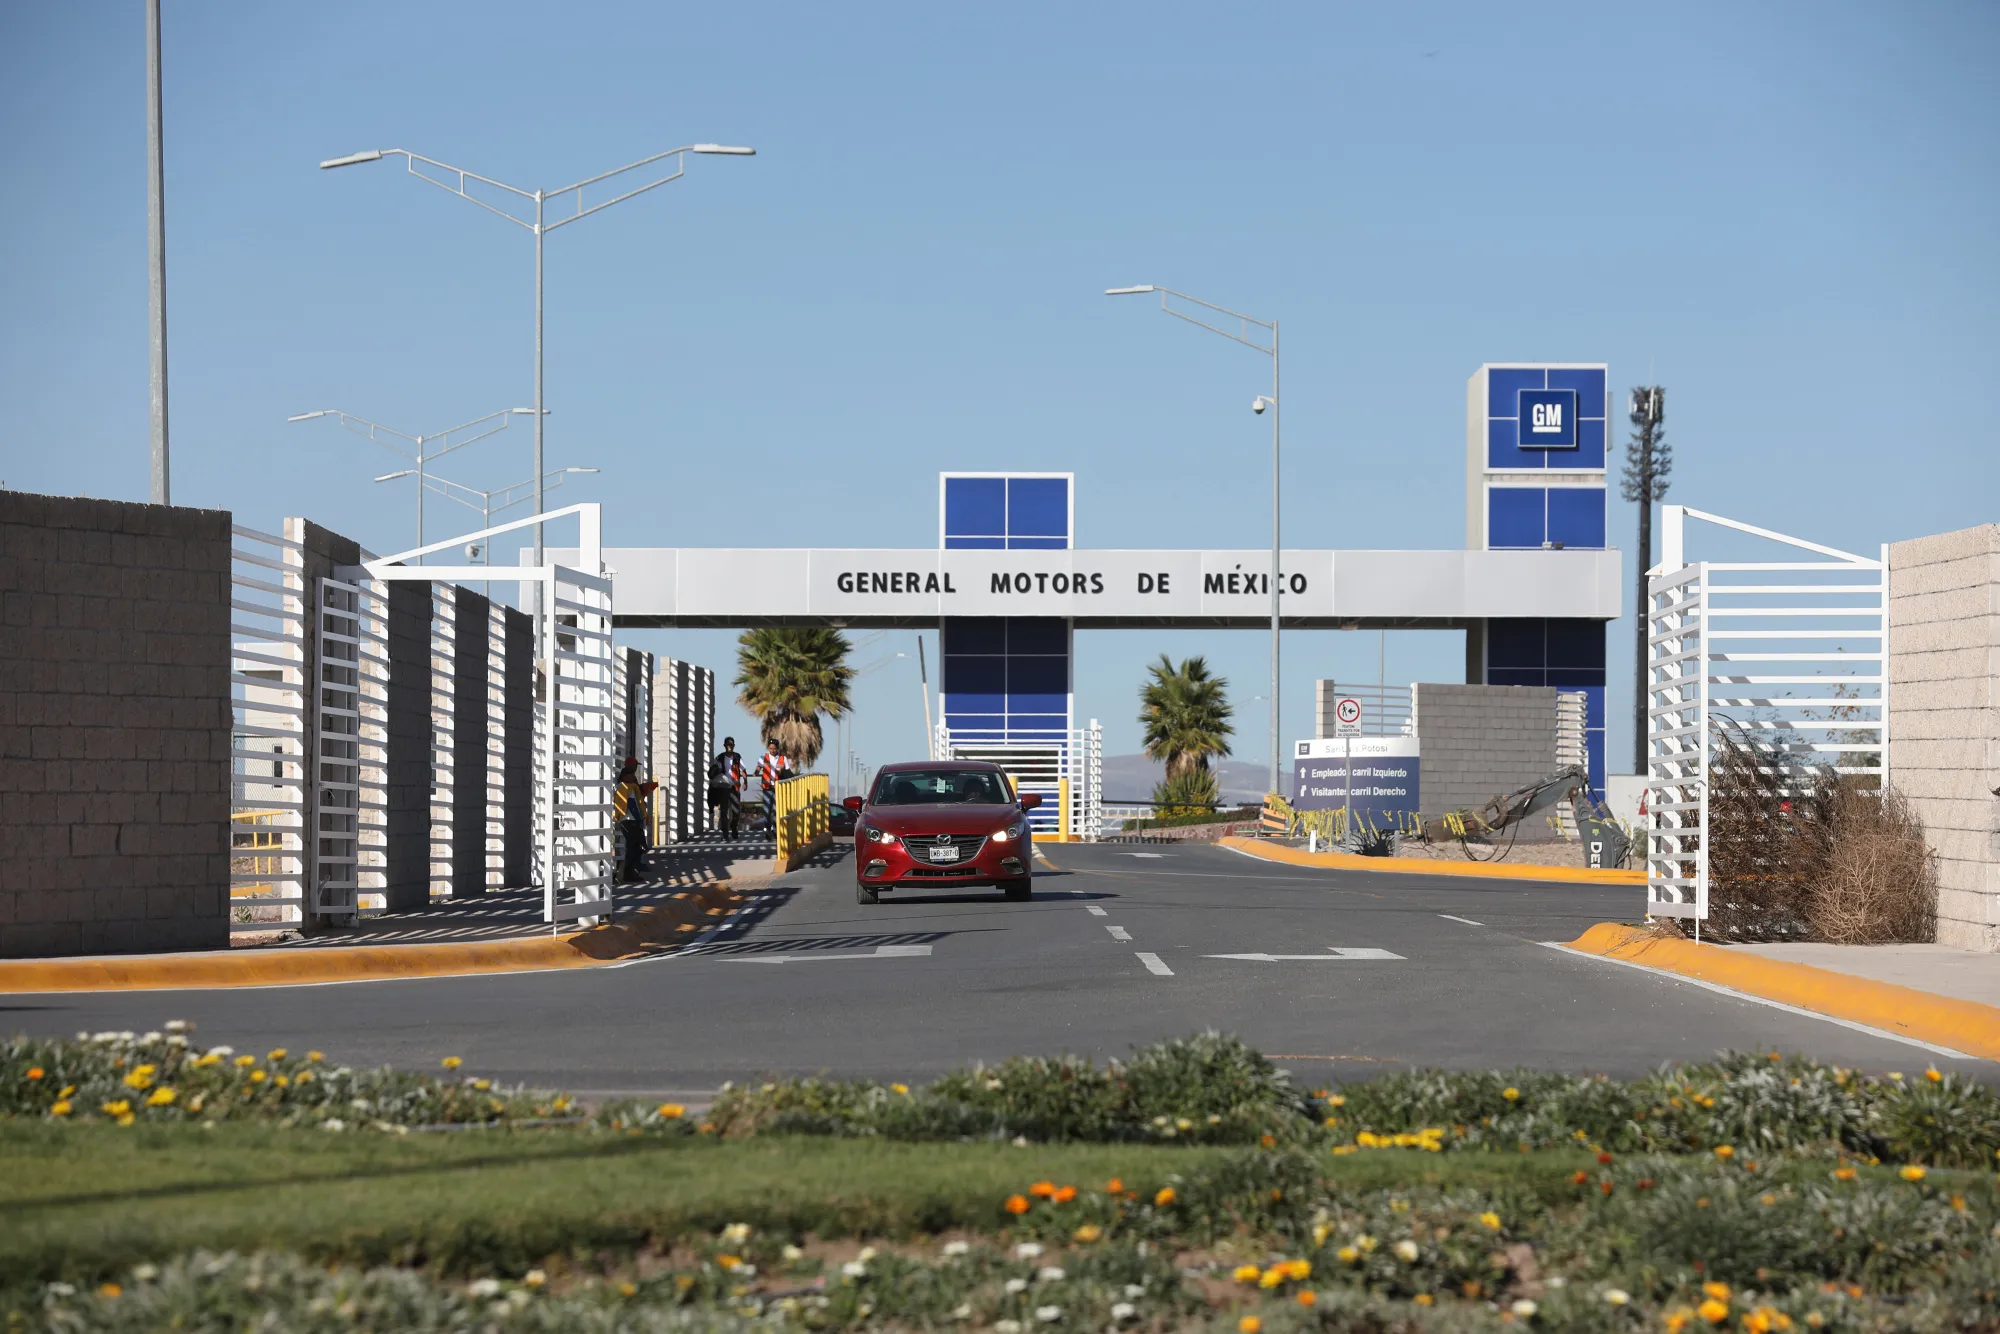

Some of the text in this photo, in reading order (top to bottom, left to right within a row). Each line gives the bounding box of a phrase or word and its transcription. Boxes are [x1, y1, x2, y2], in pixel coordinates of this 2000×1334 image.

[1532, 403, 1562, 426] GM
[837, 572, 957, 594] GENERAL
[990, 572, 1104, 594] MOTORS
[1137, 572, 1170, 594] DE
[1325, 744, 1388, 754] San Lis Potosí
[1311, 767, 1407, 780] Empleado carril Izquierdo
[1350, 786, 1371, 796] carril
[1373, 786, 1406, 796] Derecho
